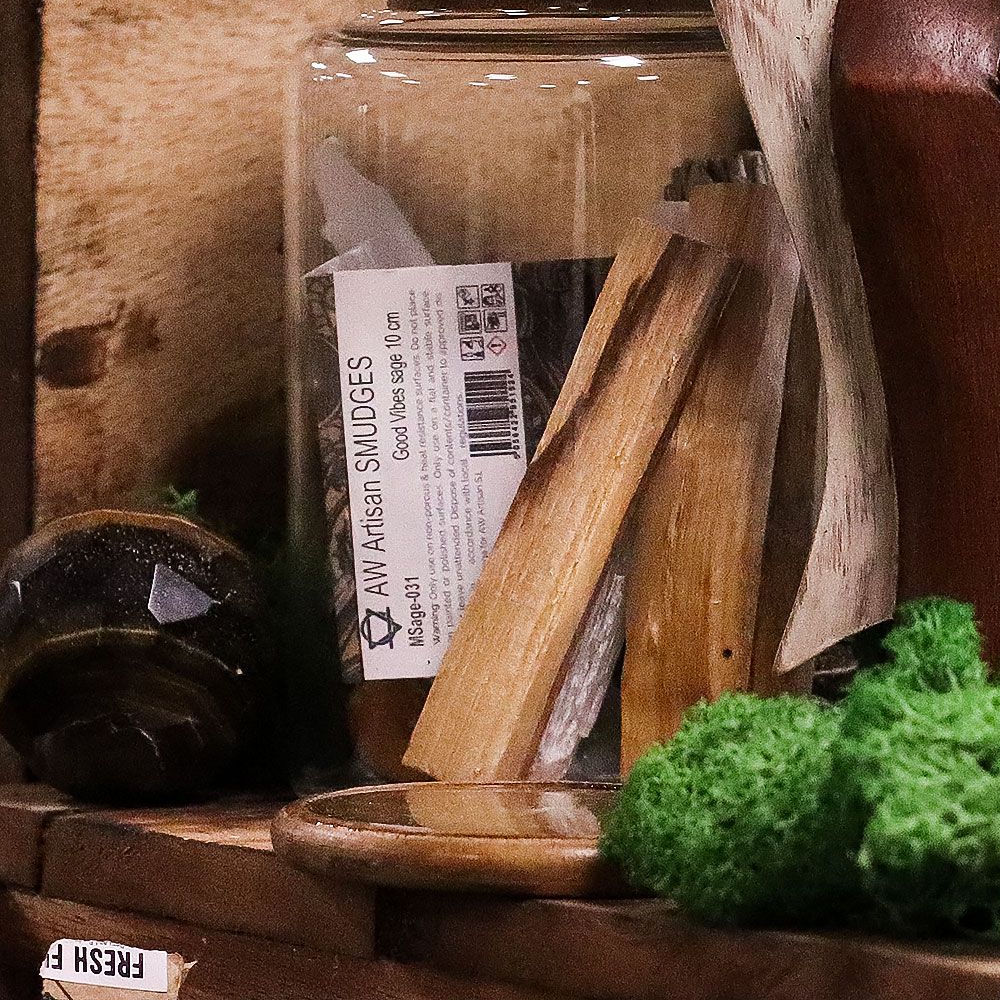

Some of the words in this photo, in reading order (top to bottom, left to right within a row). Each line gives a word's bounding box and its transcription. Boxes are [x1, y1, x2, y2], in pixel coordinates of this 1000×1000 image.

[387, 311, 401, 331] cm
[385, 333, 402, 349] 10
[389, 352, 409, 384] sage
[347, 355, 381, 473] SMUDGES
[388, 387, 407, 423] Vibes
[390, 425, 411, 461] Good
[357, 479, 386, 553] Artisan
[362, 558, 390, 598] AW
[404, 575, 429, 647] MSage-031
[74, 945, 144, 979] FRESH
